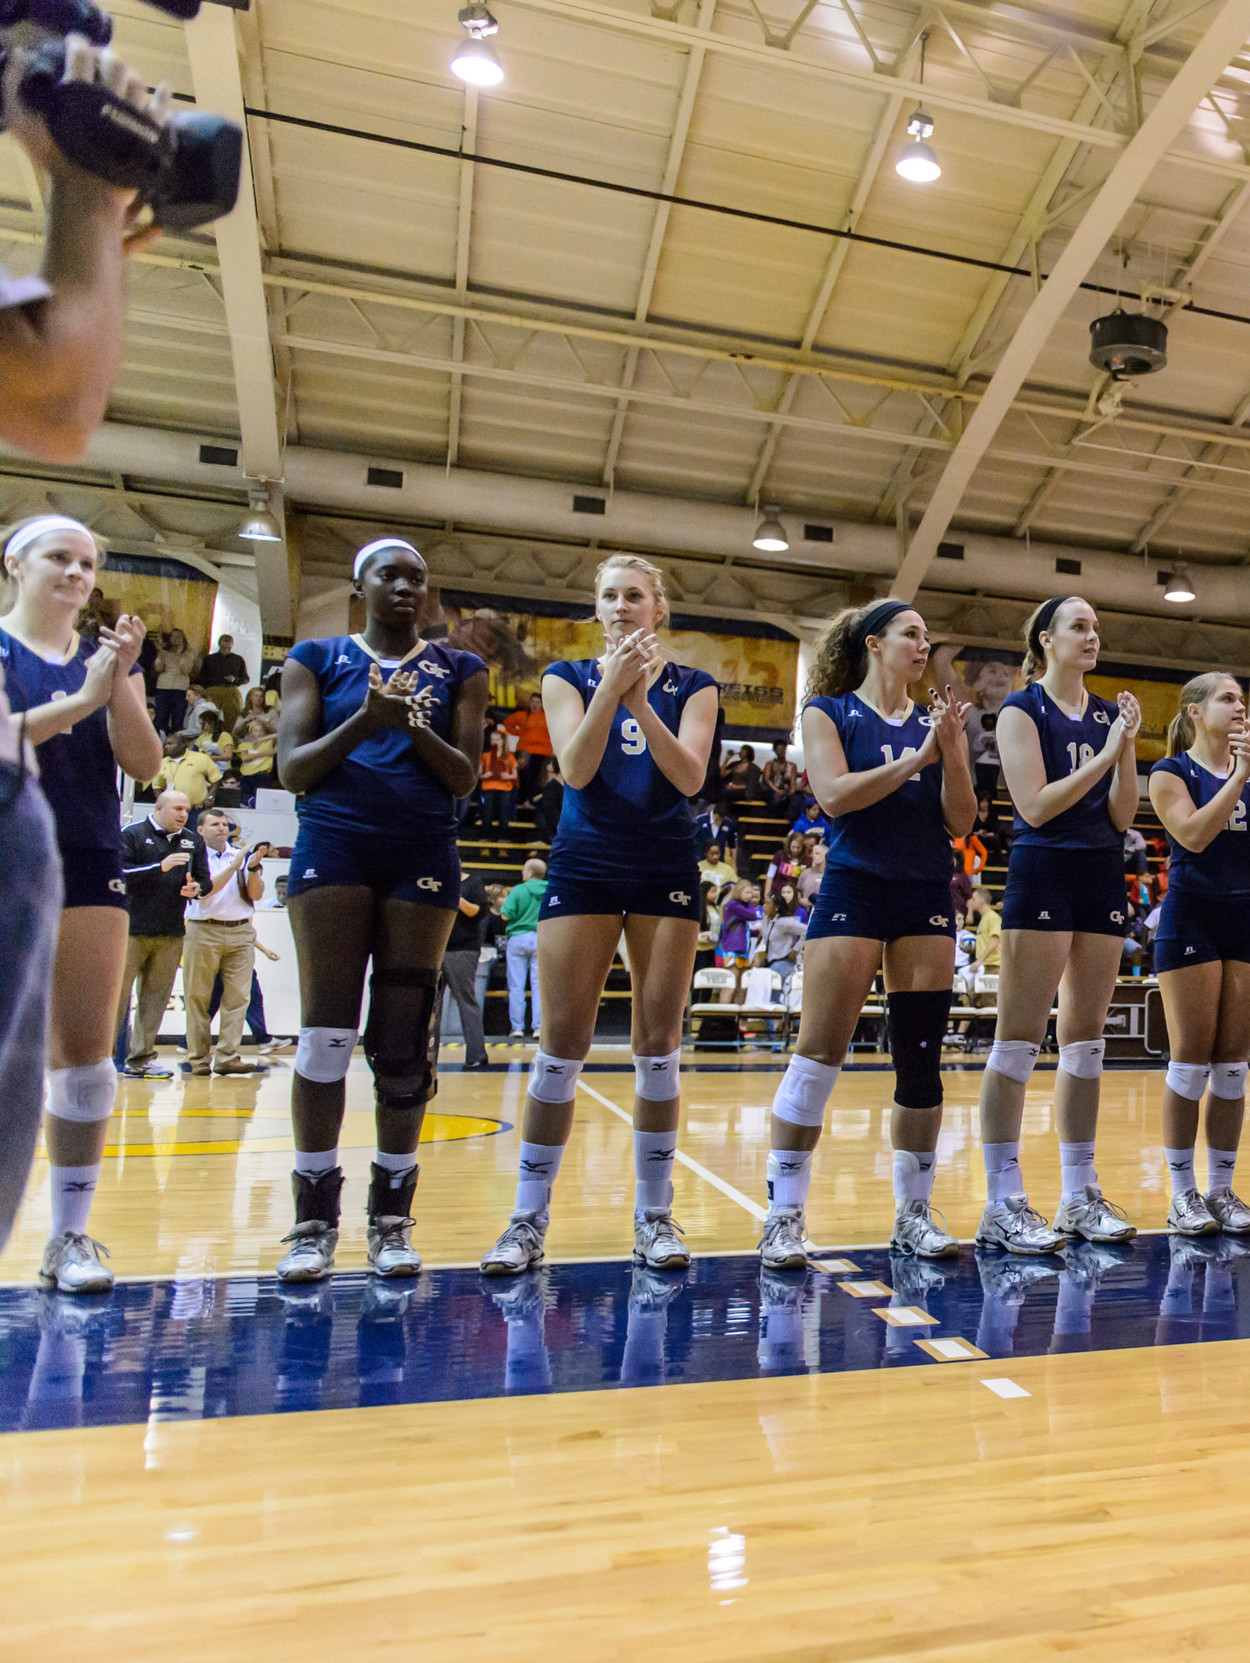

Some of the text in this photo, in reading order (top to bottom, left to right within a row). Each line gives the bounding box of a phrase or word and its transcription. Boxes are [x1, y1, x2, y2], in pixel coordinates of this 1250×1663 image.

[621, 718, 647, 755] 9
[417, 877, 443, 892] GT
[669, 891, 691, 906] GT
[929, 915, 948, 928] GT
[1109, 911, 1124, 925] GT
